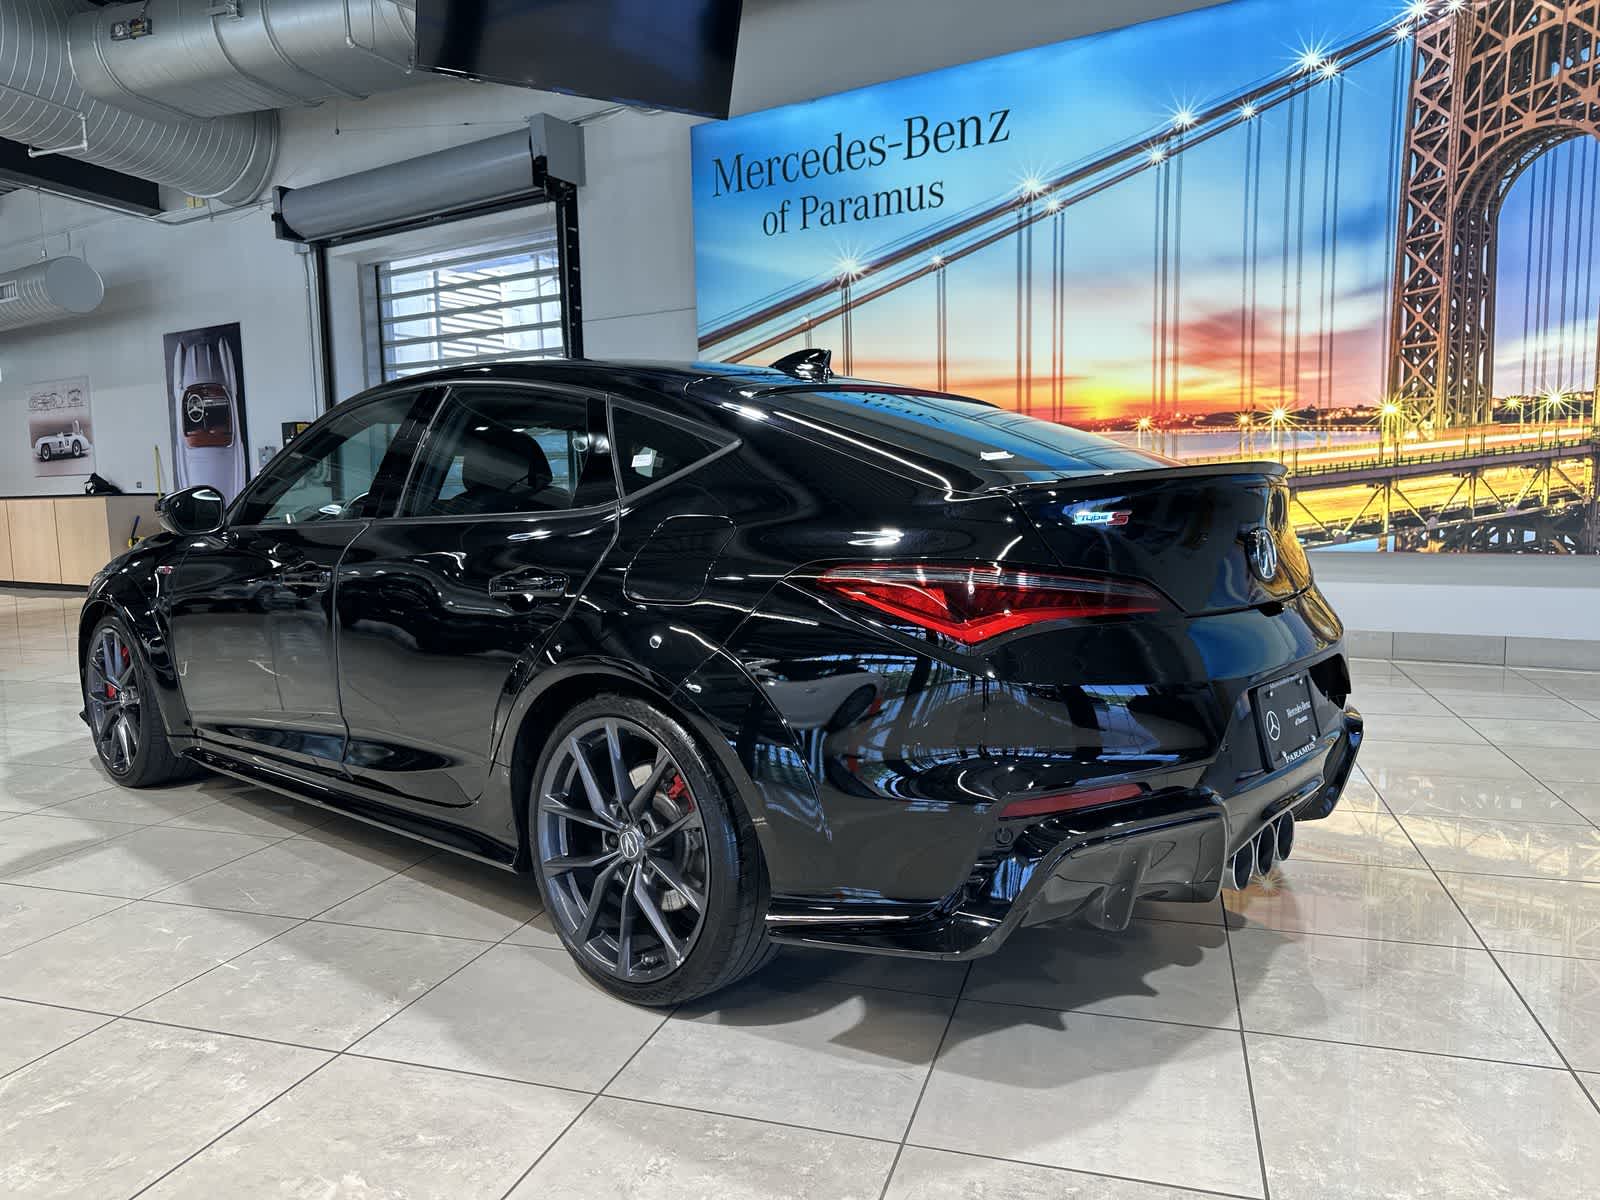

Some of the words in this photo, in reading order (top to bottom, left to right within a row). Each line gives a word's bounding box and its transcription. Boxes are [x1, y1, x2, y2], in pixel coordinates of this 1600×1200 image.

[712, 108, 1011, 198] Mercedes-Benz
[762, 199, 791, 237] of
[799, 179, 945, 231] Paramus
[1105, 510, 1132, 526] S
[1285, 742, 1316, 763] PARAMUS
